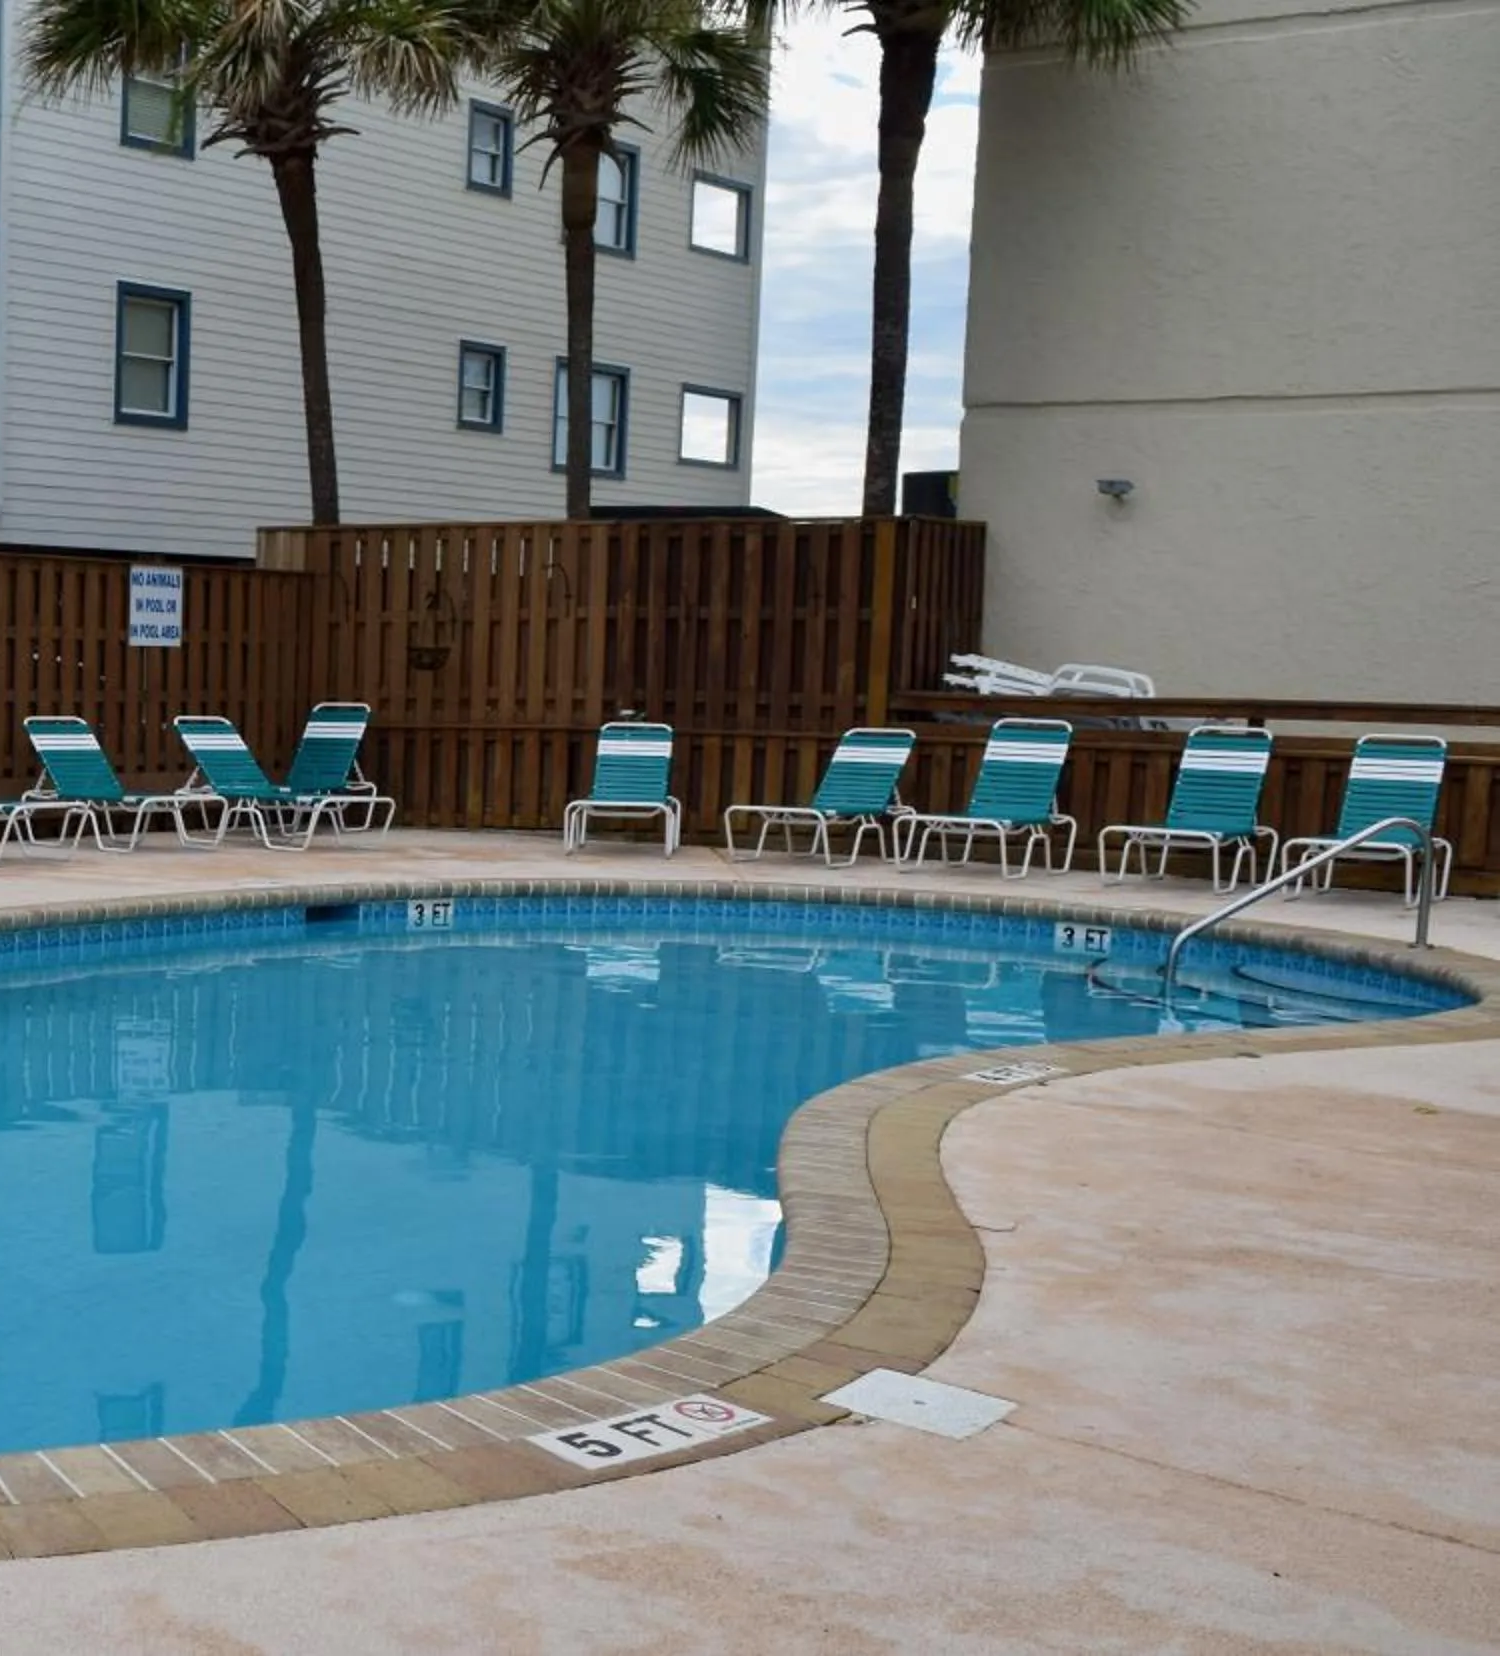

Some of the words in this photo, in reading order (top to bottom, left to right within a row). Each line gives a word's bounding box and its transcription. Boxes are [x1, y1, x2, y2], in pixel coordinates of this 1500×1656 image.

[131, 571, 144, 587] NO
[146, 571, 180, 589] ANIMALS
[146, 598, 164, 613] POOL
[140, 624, 159, 639] POOL
[161, 625, 179, 639] AREA
[415, 904, 425, 926] 3
[1063, 927, 1075, 948] 3
[556, 1431, 623, 1458] 5
[608, 1413, 693, 1447] FT
